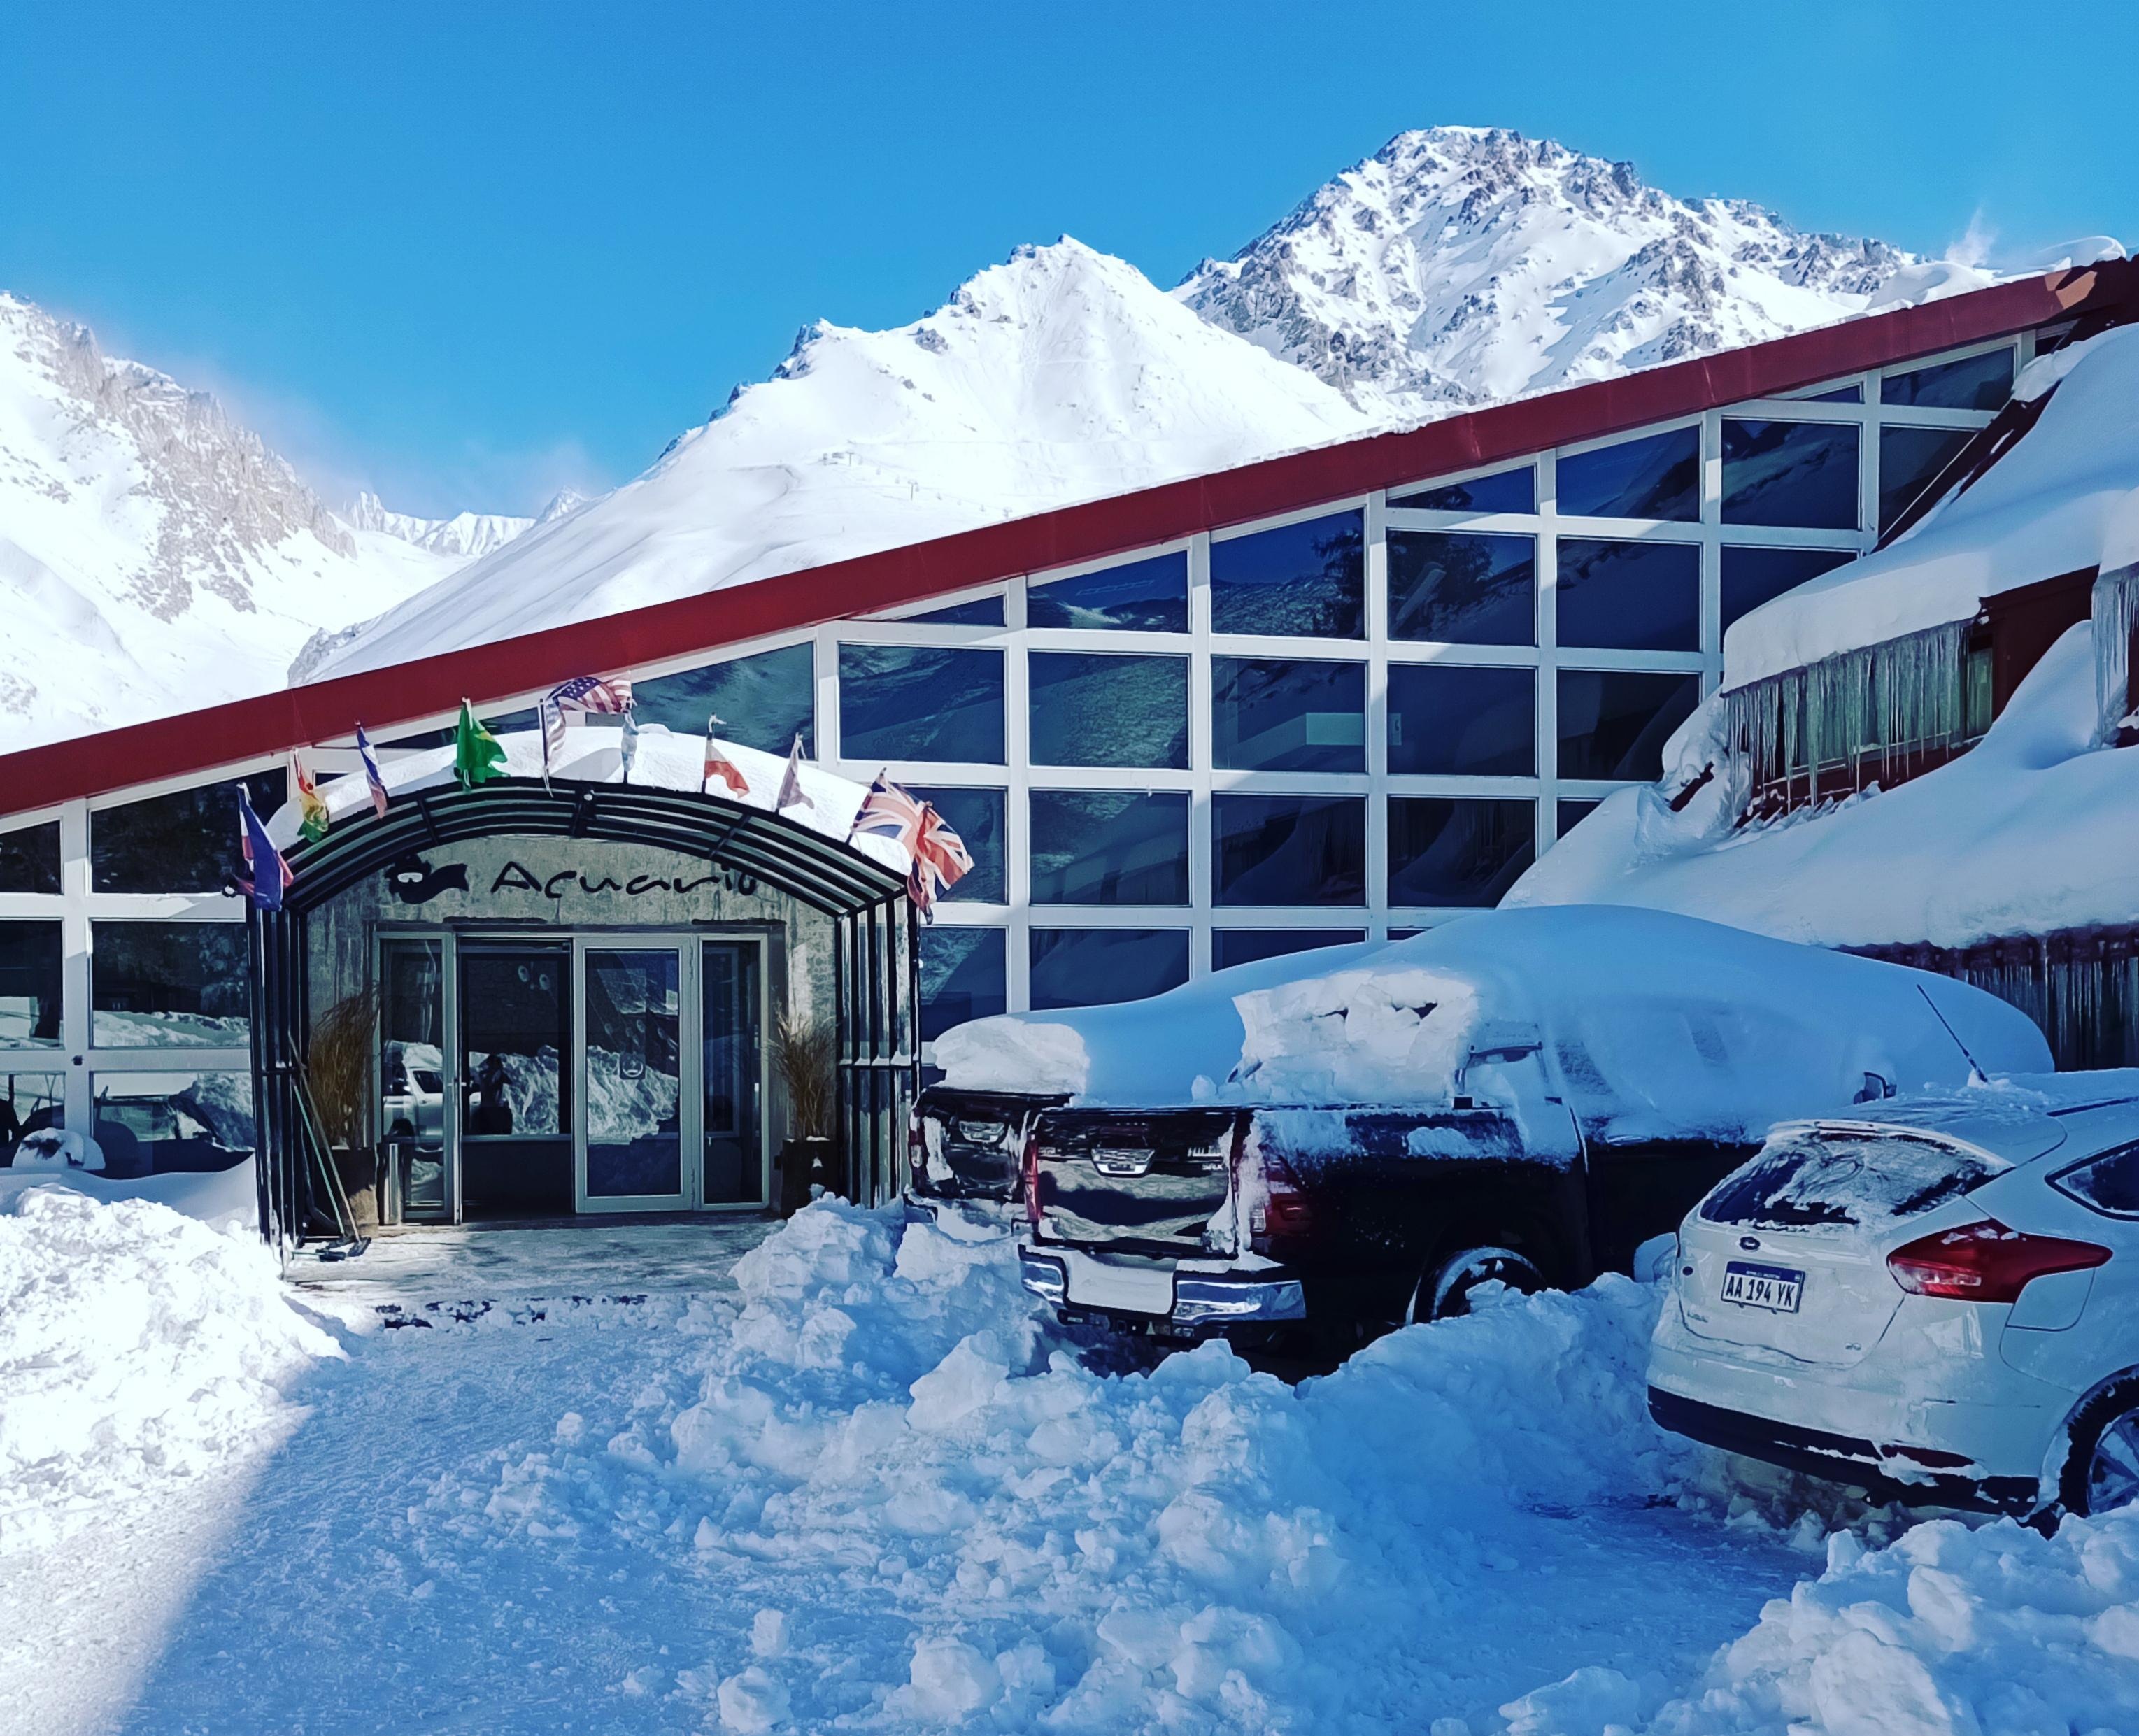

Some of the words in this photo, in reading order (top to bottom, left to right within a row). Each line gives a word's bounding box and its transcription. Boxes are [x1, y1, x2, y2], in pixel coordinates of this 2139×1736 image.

[492, 861, 756, 898] Acuario
[1726, 1276, 1742, 1298] AA
[1746, 1279, 1772, 1302] 194
[1777, 1283, 1795, 1307] YK
